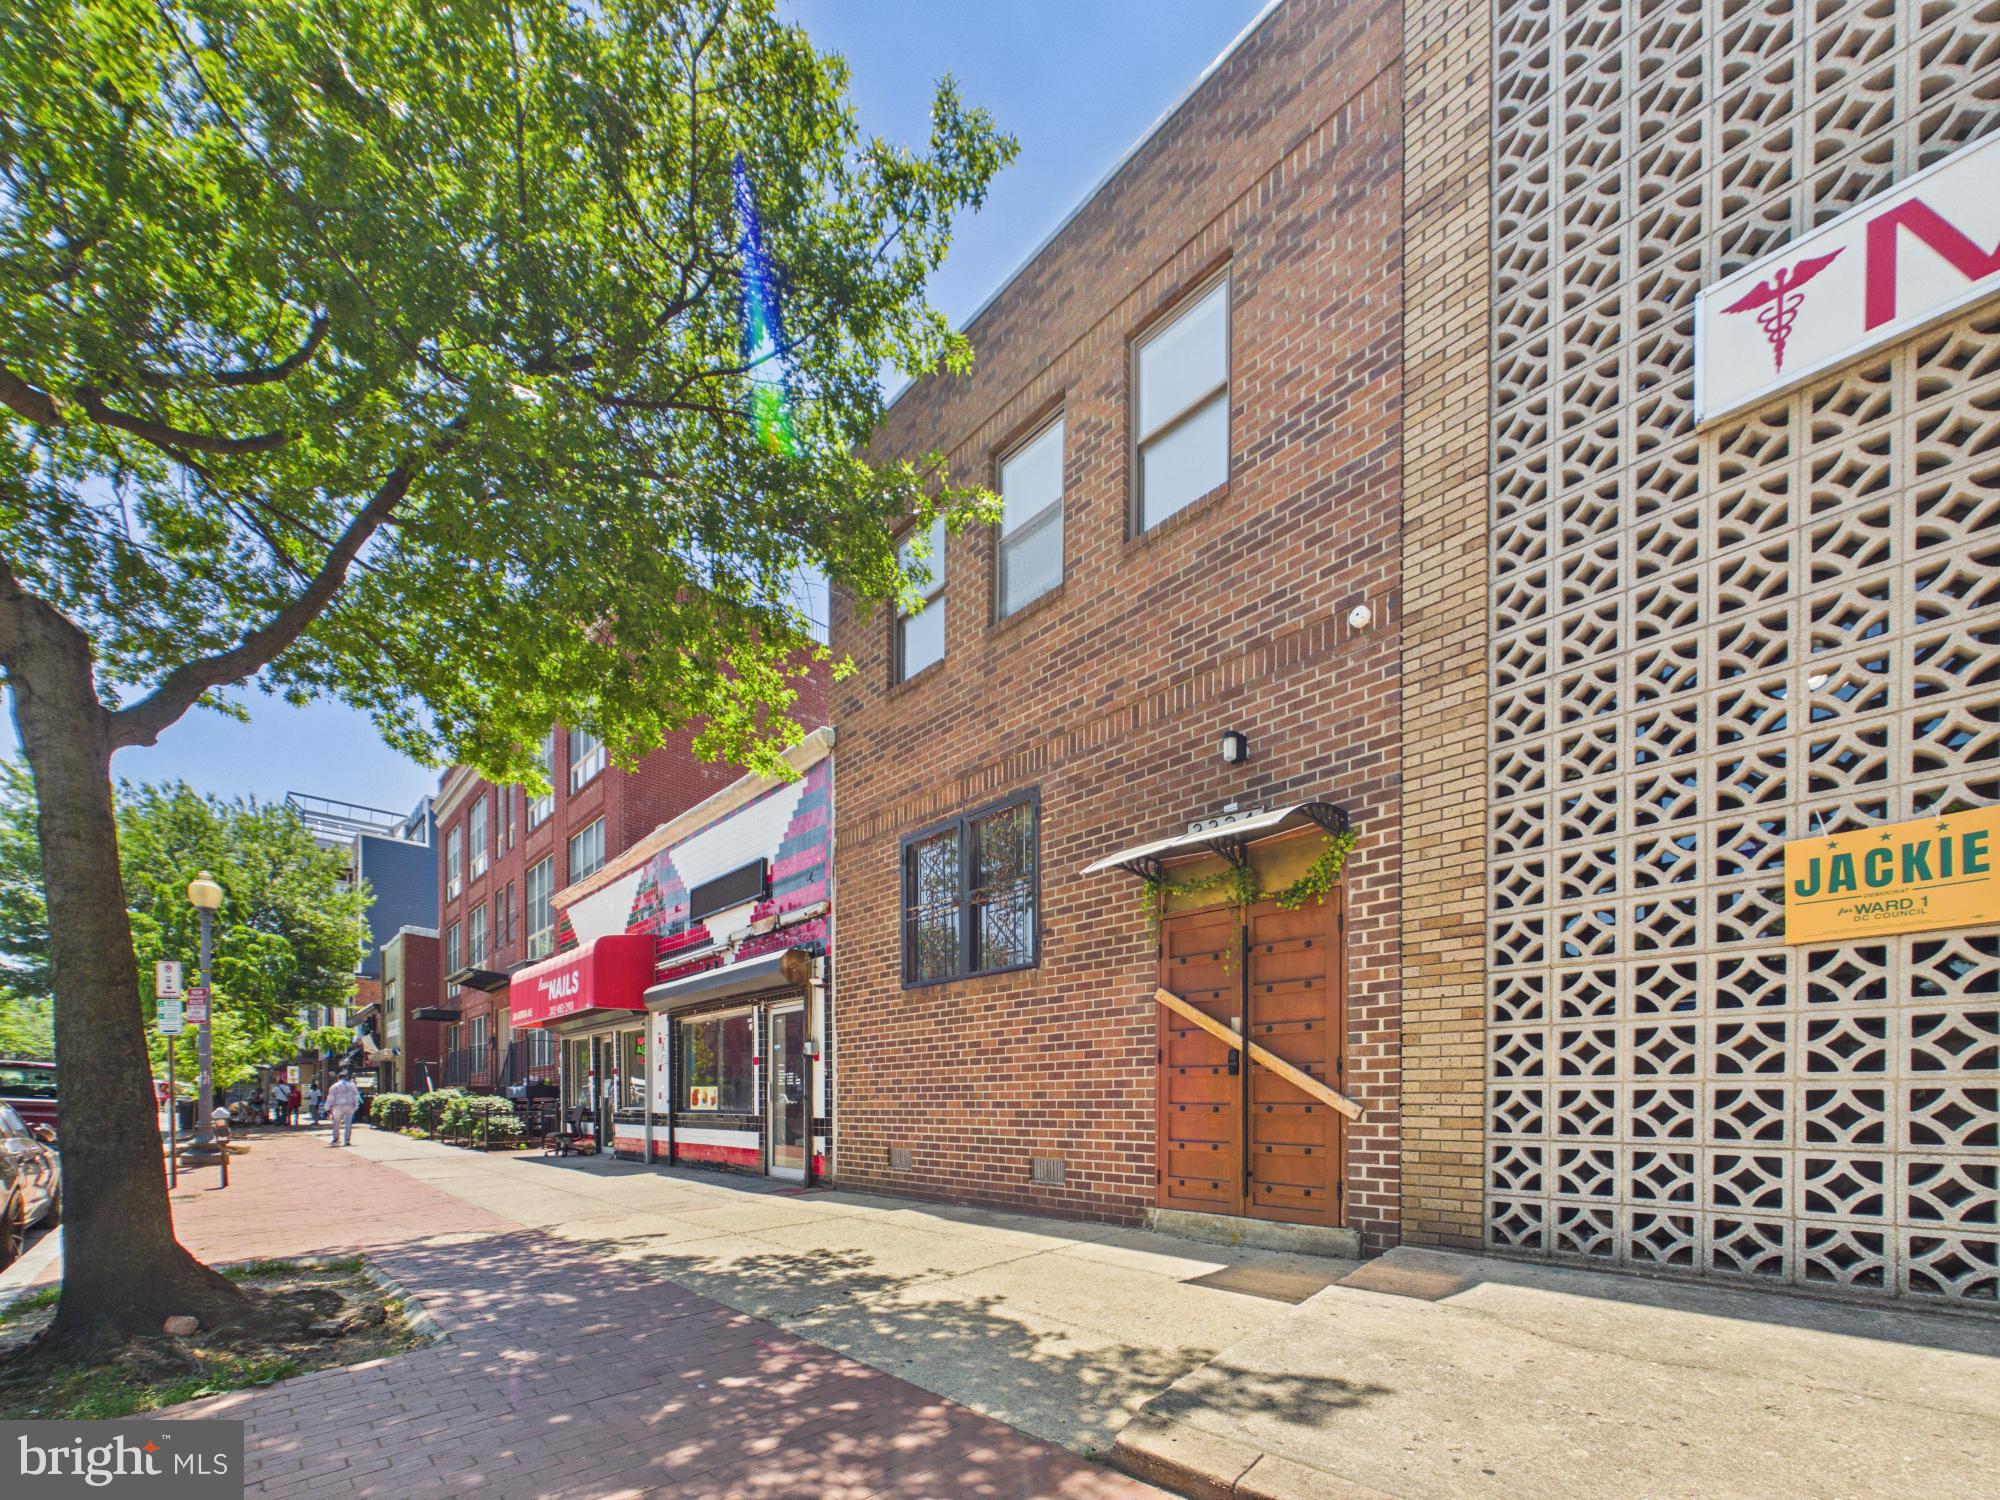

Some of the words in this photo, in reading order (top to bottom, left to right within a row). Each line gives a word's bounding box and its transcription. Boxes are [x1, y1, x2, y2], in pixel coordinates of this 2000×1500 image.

[1794, 829, 1991, 897] JACKIE
[1863, 887, 1911, 899] DEMOCRAT
[1854, 914, 1869, 922] DC
[1874, 908, 1928, 920] COUNCIL
[1855, 898, 1914, 915] WARD
[1921, 896, 1928, 907] 1
[548, 970, 579, 1000] NAILS
